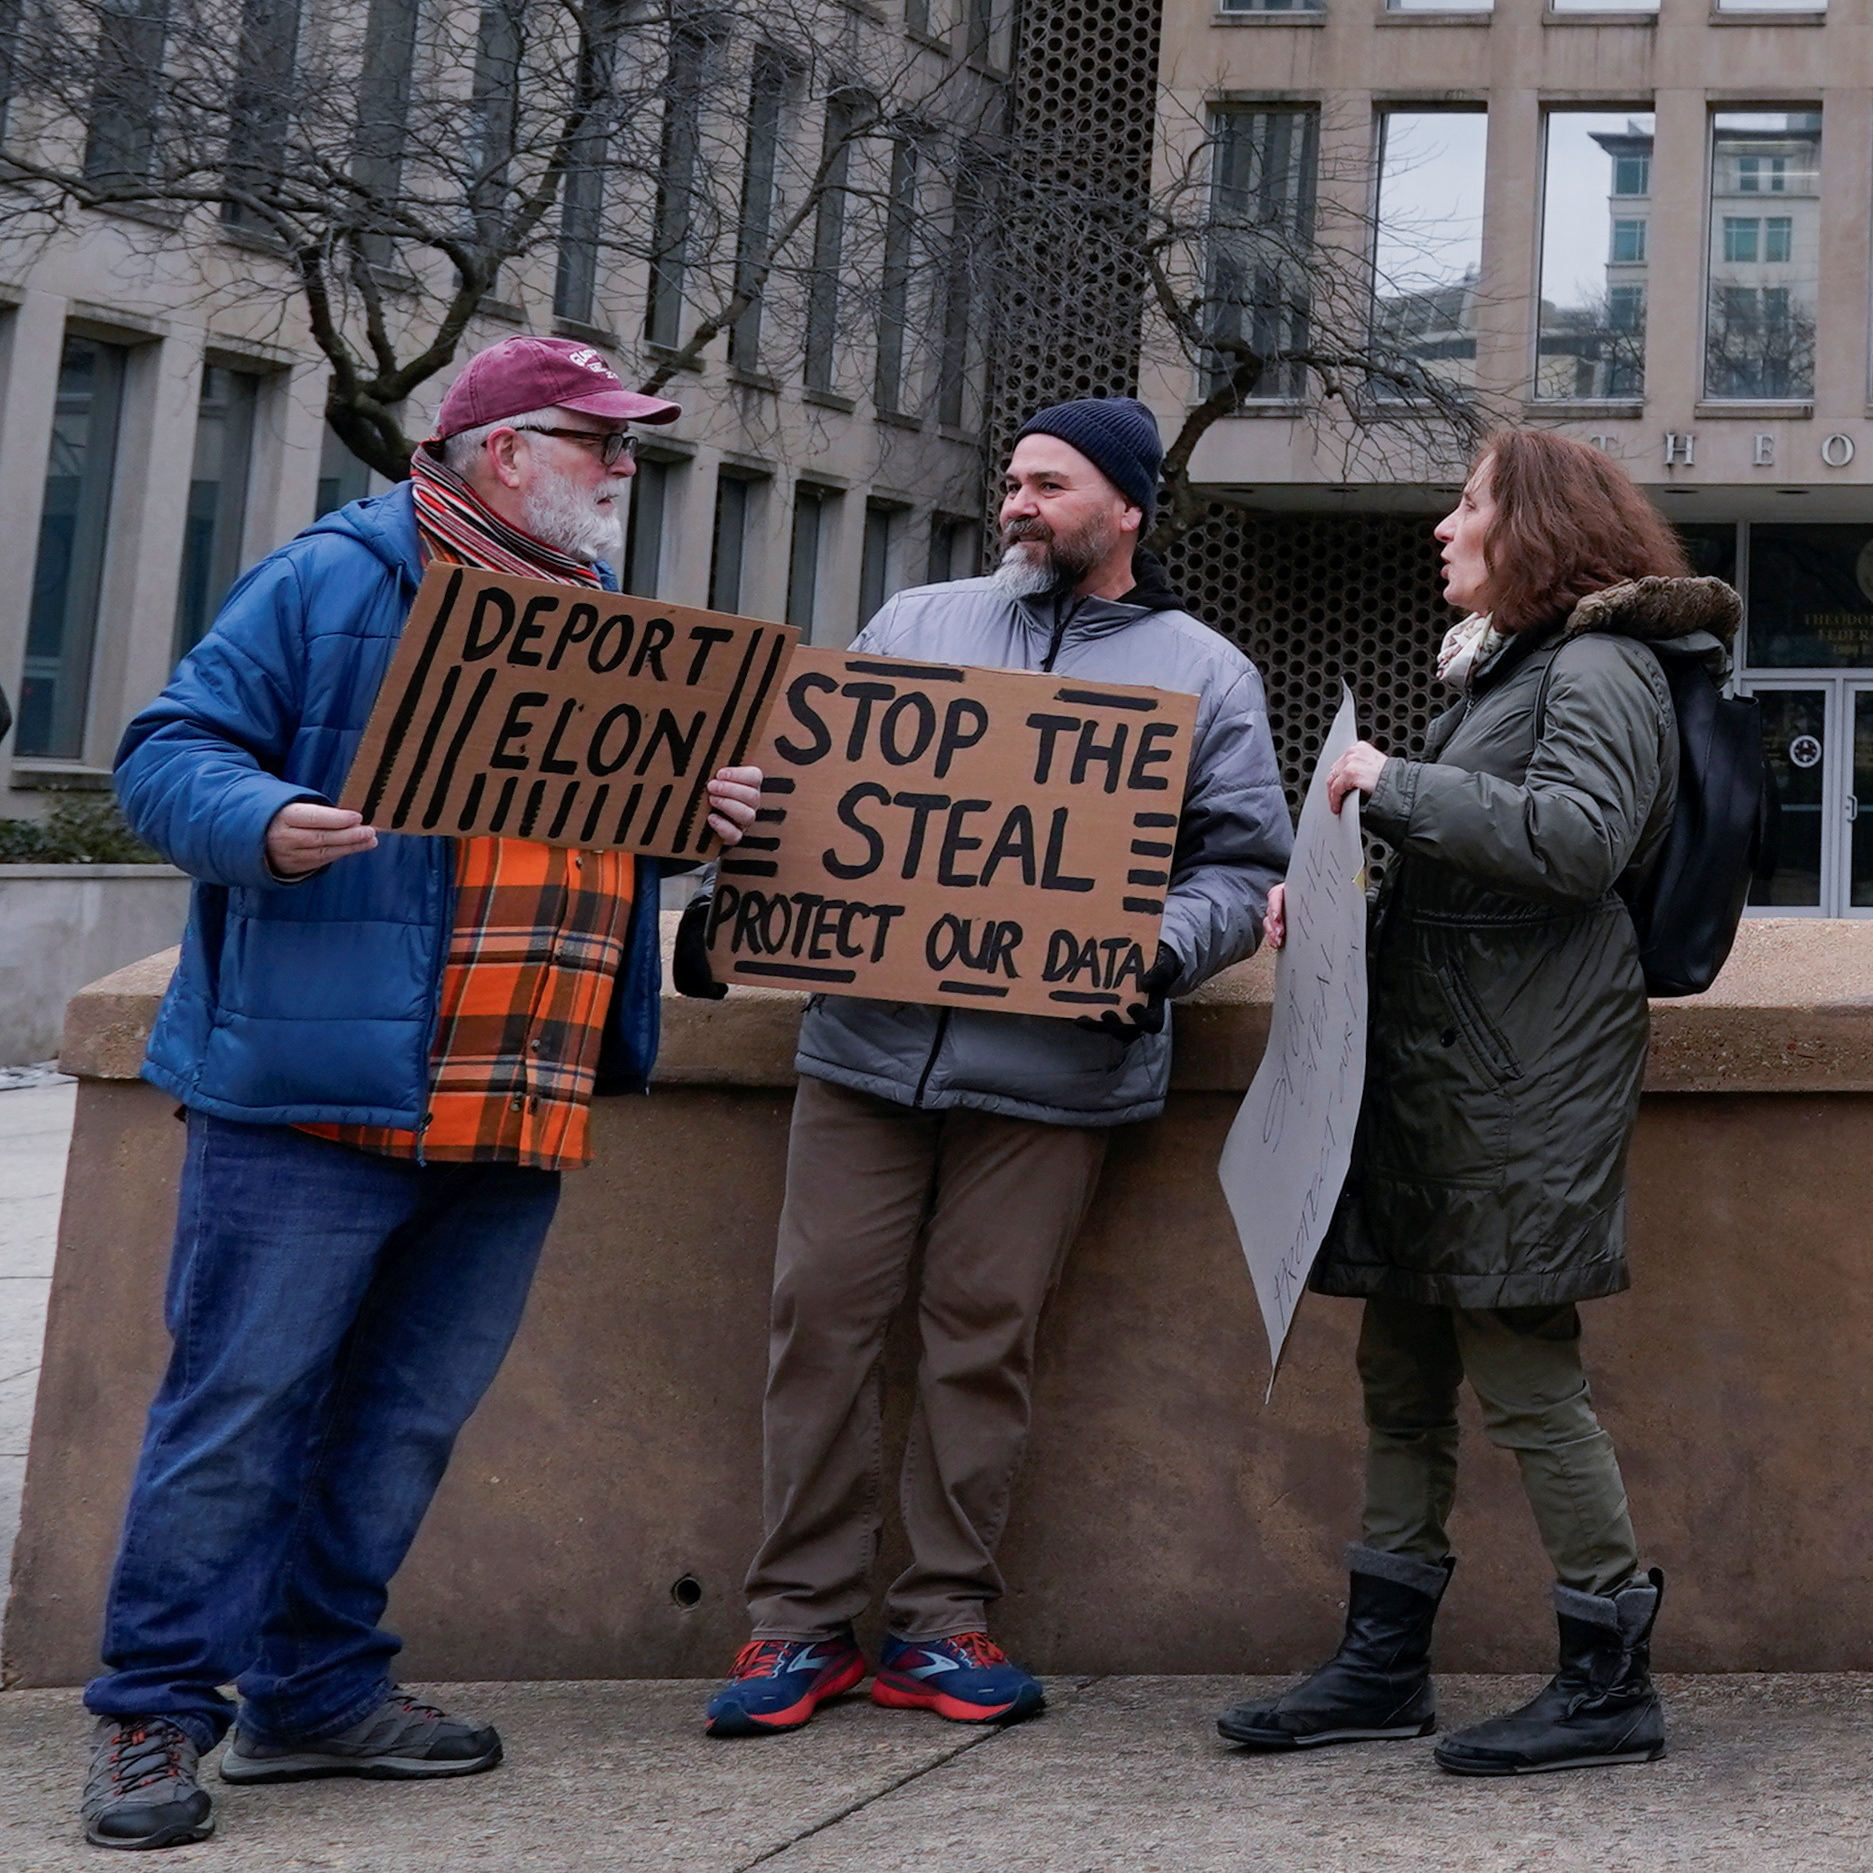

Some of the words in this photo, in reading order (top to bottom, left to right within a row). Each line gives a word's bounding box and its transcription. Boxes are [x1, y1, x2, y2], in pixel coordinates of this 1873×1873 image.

[461, 586, 734, 686] DEPORT
[489, 691, 707, 778] ELON
[774, 671, 990, 779] STOP
[1025, 713, 1179, 794] THE
[822, 781, 1097, 893] STEAL
[705, 883, 906, 964] PROTECT
[924, 912, 1024, 980] OUR
[1040, 929, 1149, 994] DATA
